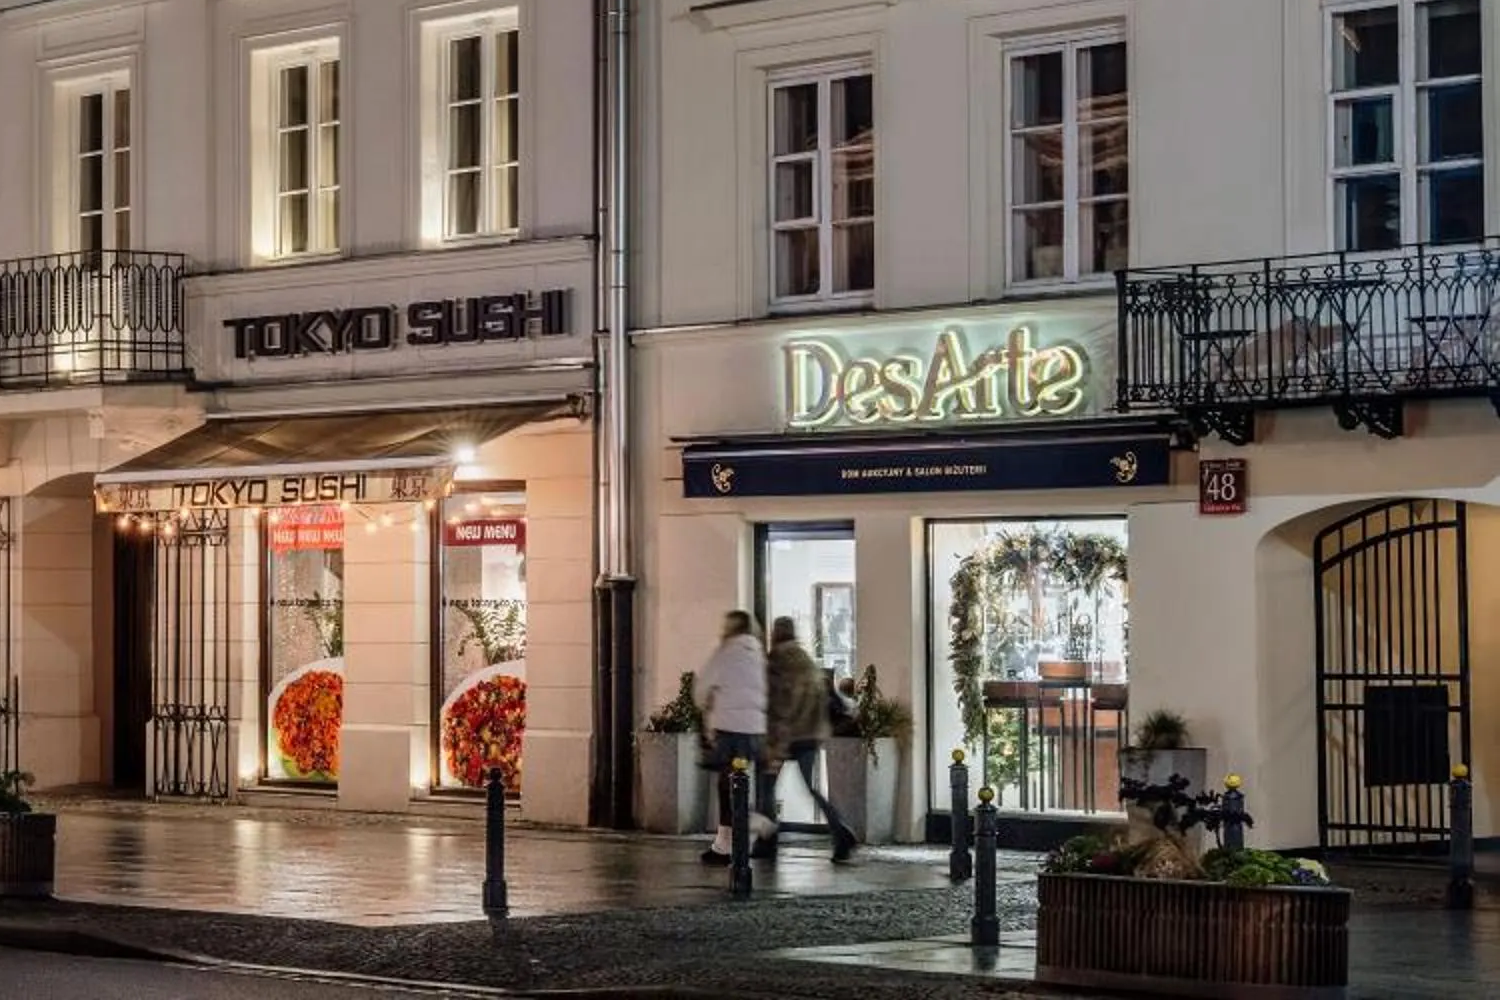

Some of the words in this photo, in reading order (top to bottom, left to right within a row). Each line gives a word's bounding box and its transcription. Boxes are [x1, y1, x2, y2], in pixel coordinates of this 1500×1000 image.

[223, 305, 396, 359] TOKYO
[407, 289, 570, 345] SUSHI
[785, 326, 1090, 427] DesArte
[173, 479, 268, 507] TOKYO
[280, 473, 368, 502] SUSHI
[1207, 473, 1236, 501] 48
